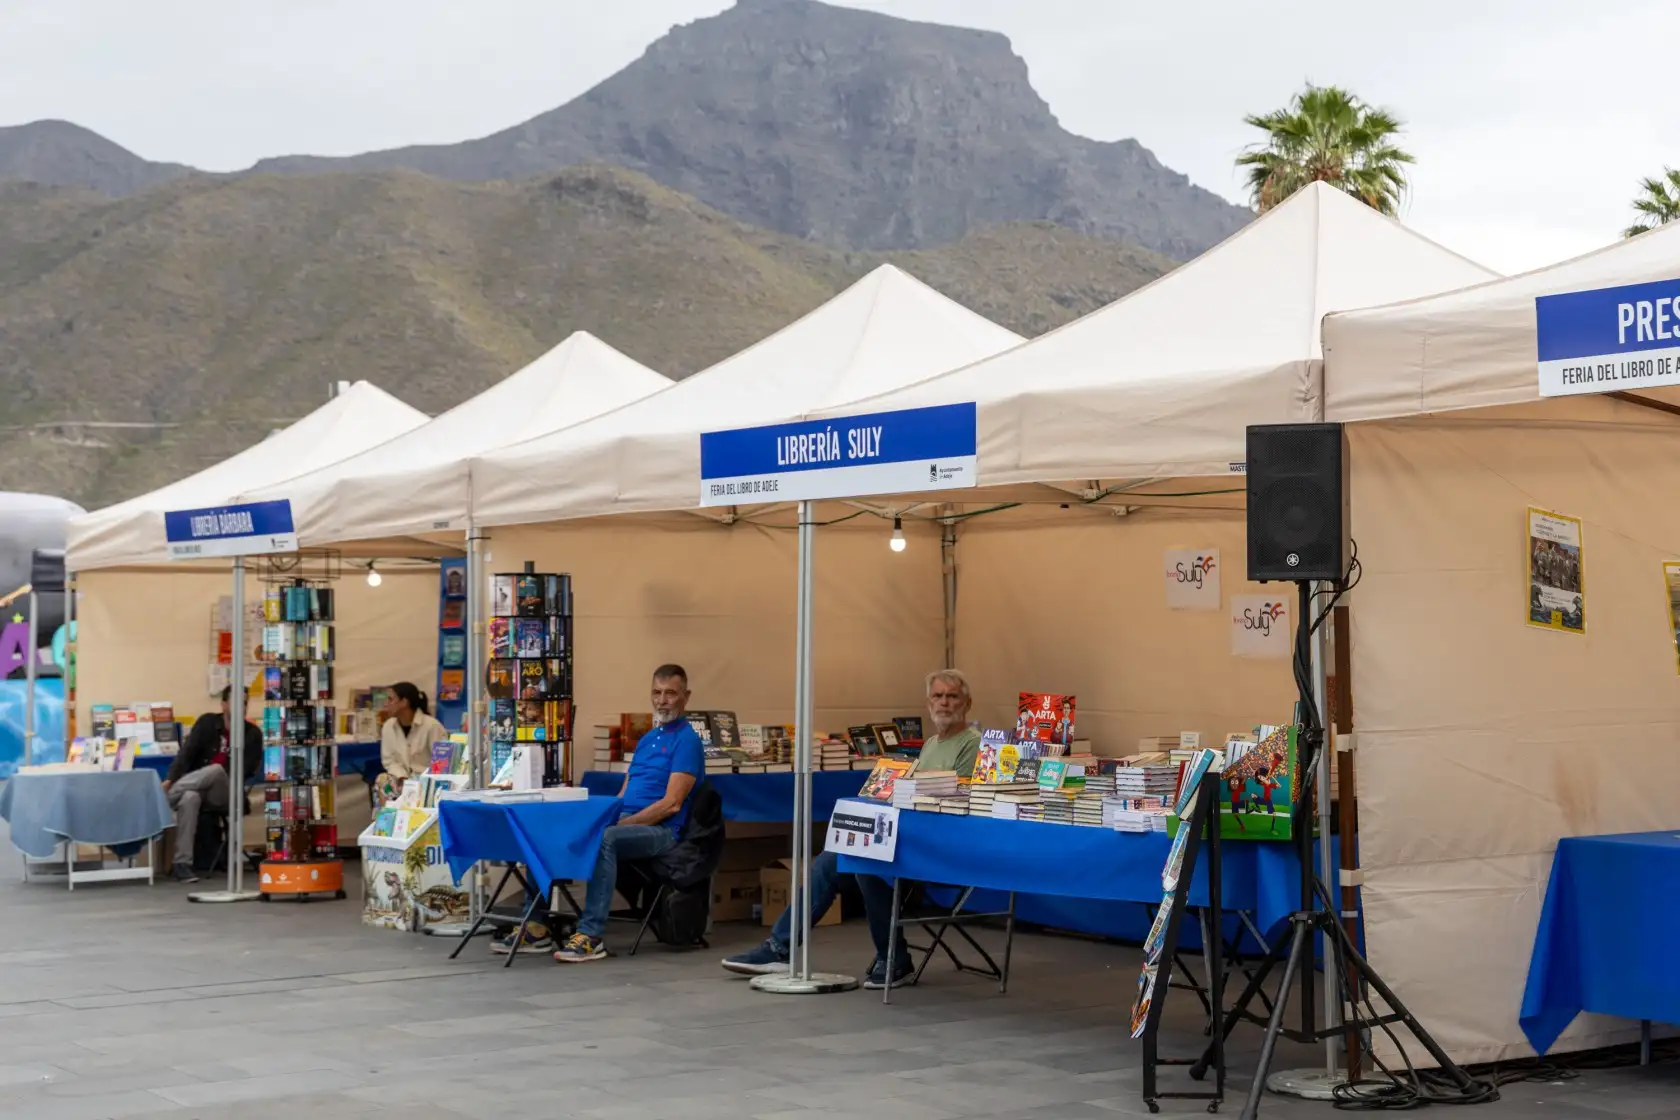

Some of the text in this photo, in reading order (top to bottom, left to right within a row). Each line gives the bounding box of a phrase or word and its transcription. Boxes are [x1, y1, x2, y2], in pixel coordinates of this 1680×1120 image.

[1562, 366, 1594, 385] FERIA
[1597, 363, 1618, 382] DEL
[1621, 359, 1653, 379] LIBRO
[1657, 357, 1672, 376] DE
[777, 426, 883, 466] LIBRERÍA SULY
[710, 479, 779, 497] FERIA DEL LIBRO DE ADEJE
[1176, 562, 1203, 589] Suly
[1244, 608, 1270, 637] Suly
[983, 729, 1005, 740] ARTA
